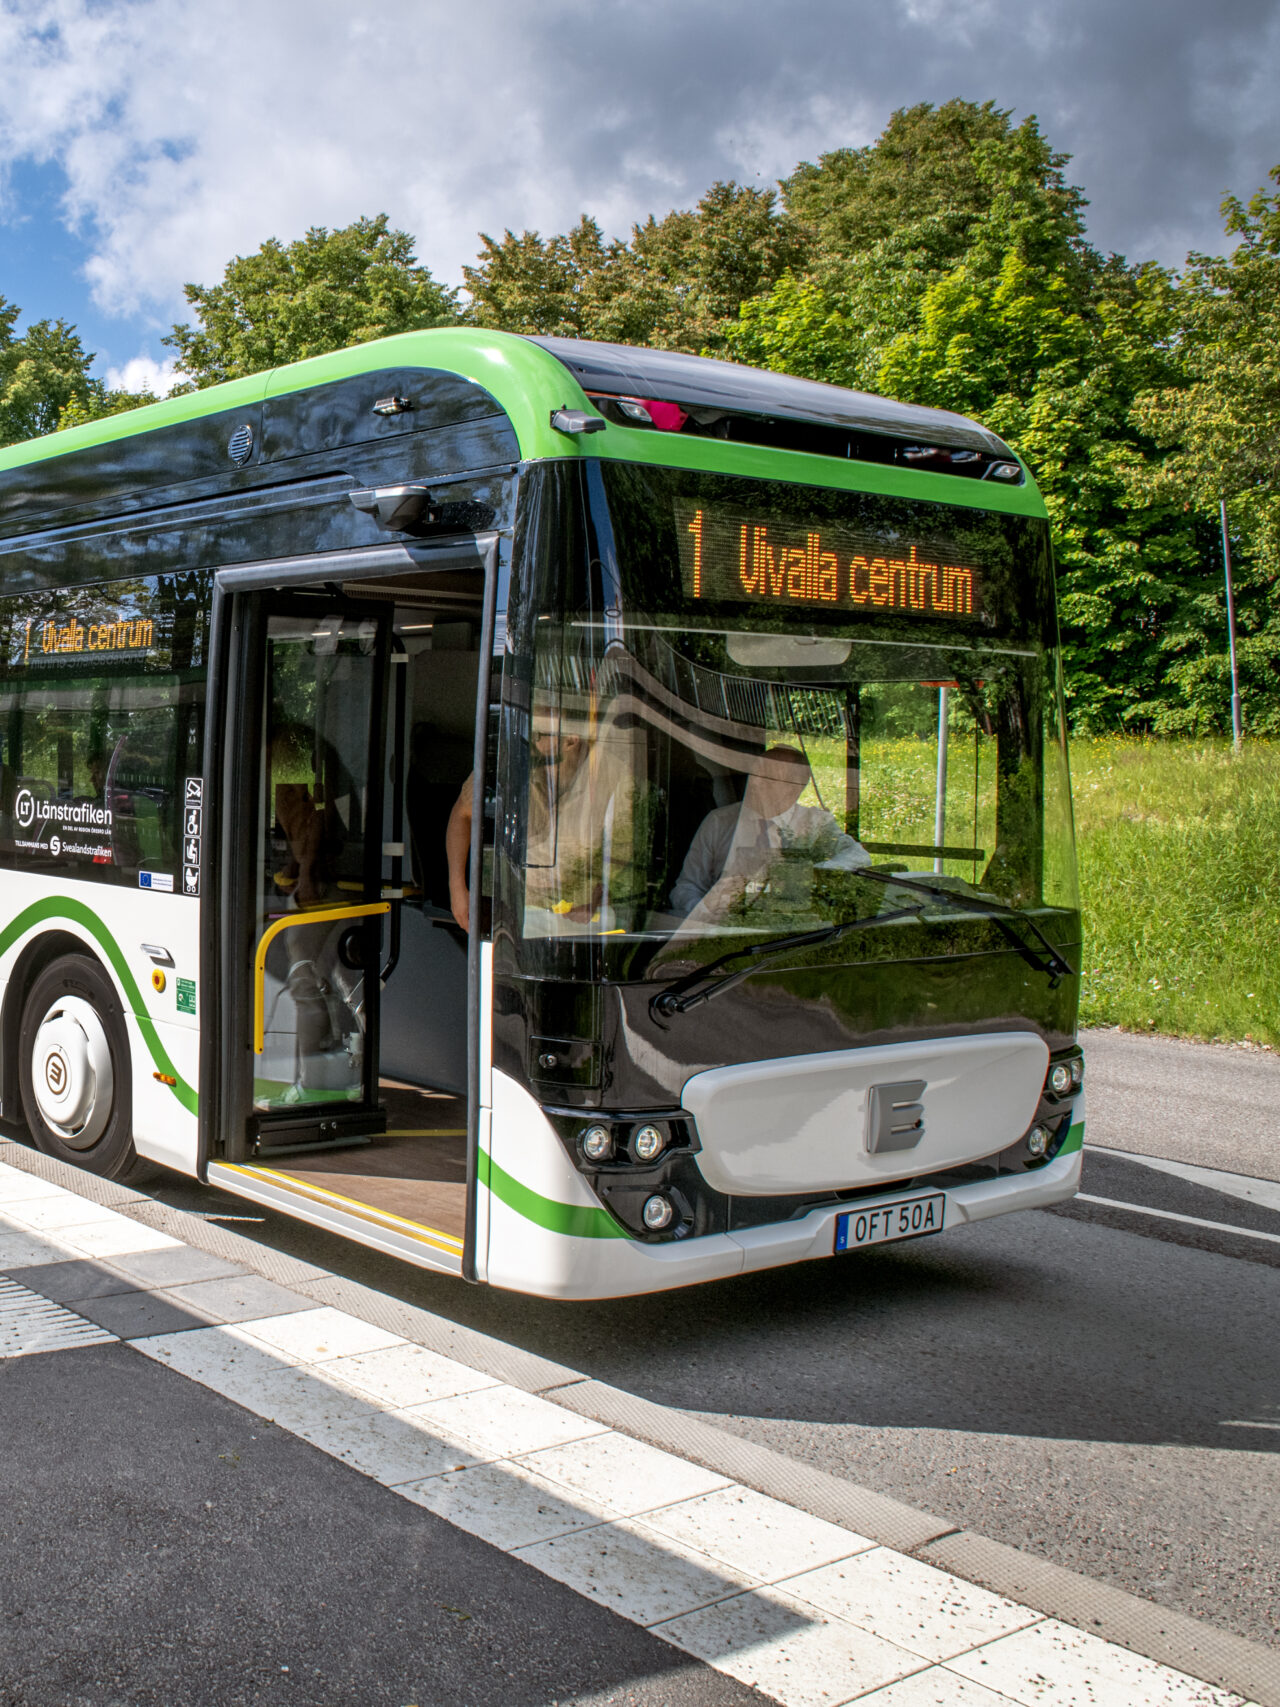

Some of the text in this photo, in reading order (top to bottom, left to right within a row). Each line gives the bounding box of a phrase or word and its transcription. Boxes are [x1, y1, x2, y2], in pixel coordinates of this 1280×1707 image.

[688, 510, 972, 613] 1 Vivalla centrum
[24, 613, 152, 661] 1 Vivalla centrum
[20, 801, 30, 815] LT
[36, 800, 112, 825] Länstrafiken
[62, 841, 112, 857] Svealandstrafiken
[855, 1209, 893, 1242] OFT
[898, 1202, 934, 1233] 50A
